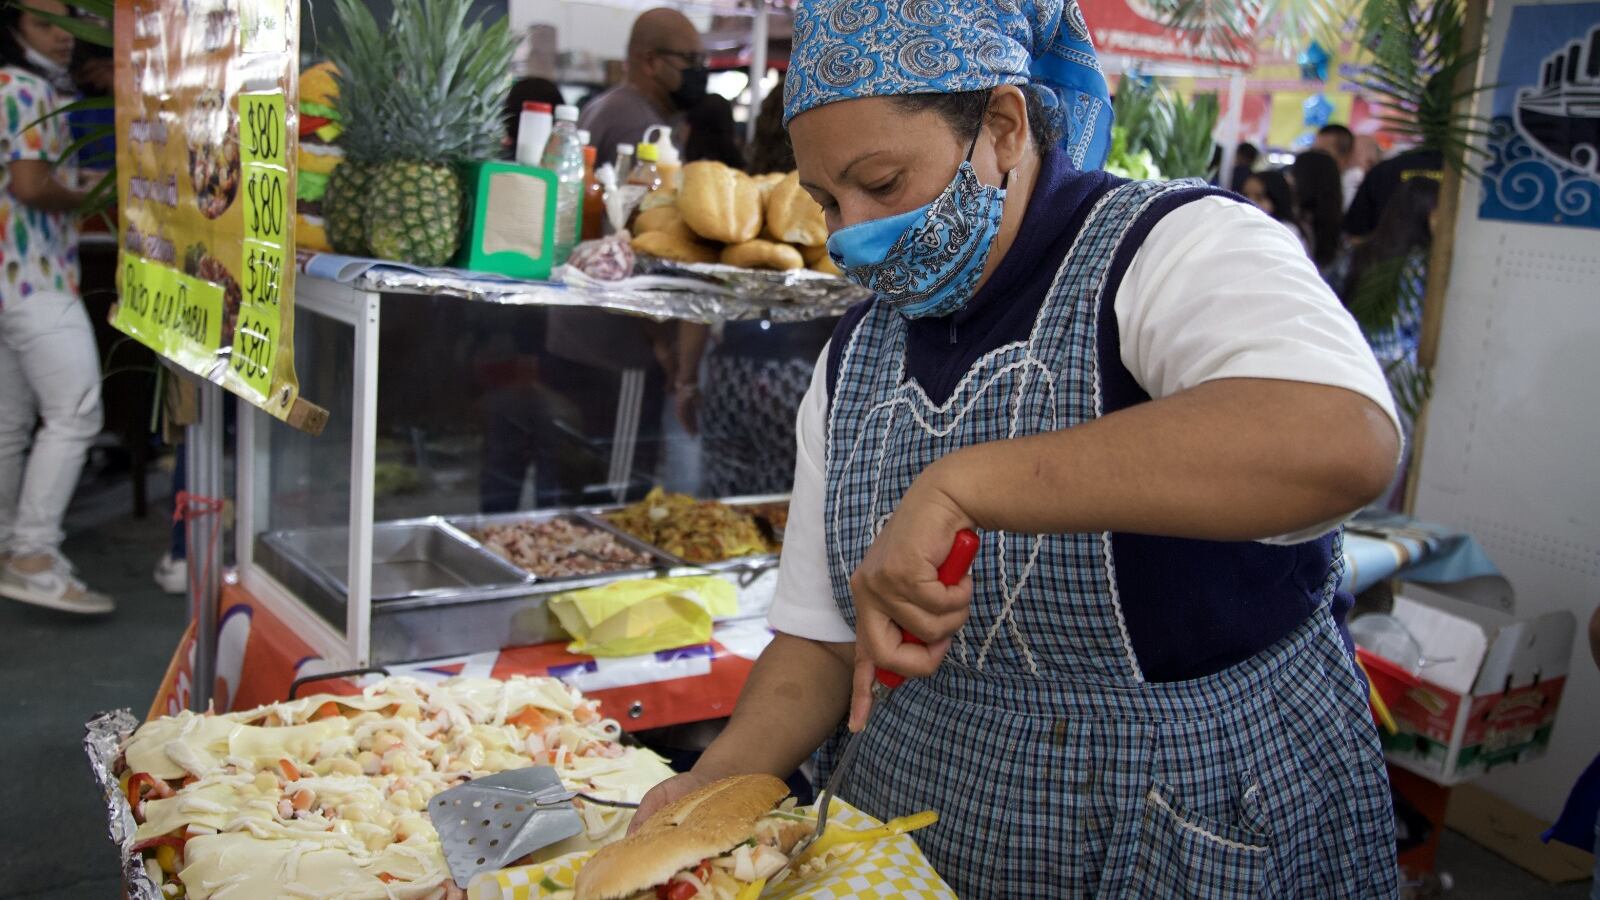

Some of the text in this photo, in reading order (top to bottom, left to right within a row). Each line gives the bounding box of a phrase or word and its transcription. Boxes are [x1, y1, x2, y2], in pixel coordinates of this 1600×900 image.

[249, 101, 279, 159] $80
[249, 173, 283, 237] $80
[246, 249, 280, 305] $100
[234, 317, 271, 379] $80
